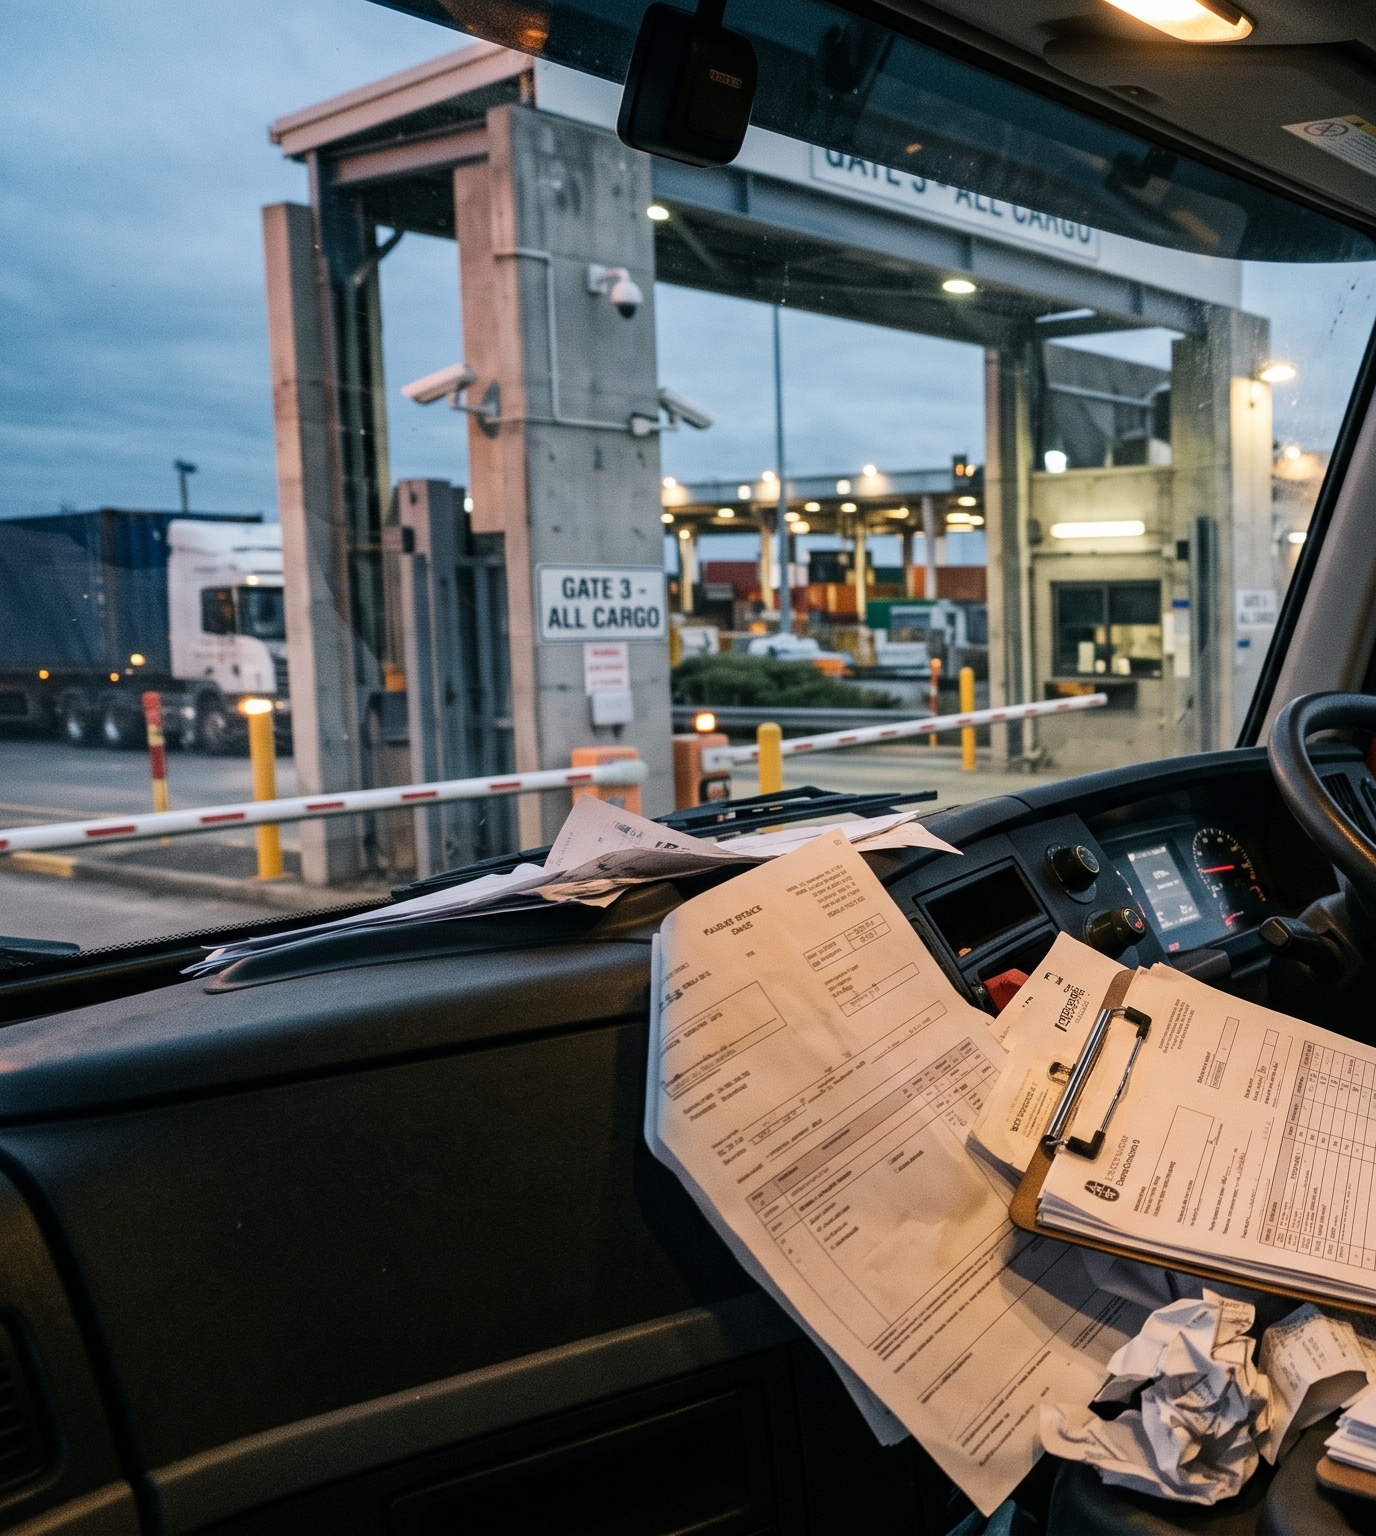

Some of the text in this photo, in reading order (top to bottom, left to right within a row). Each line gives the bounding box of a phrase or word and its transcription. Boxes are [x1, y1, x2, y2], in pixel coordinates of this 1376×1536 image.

[562, 577, 612, 599] GATE
[620, 577, 632, 599] 3
[549, 606, 660, 629] ALL CARGO
